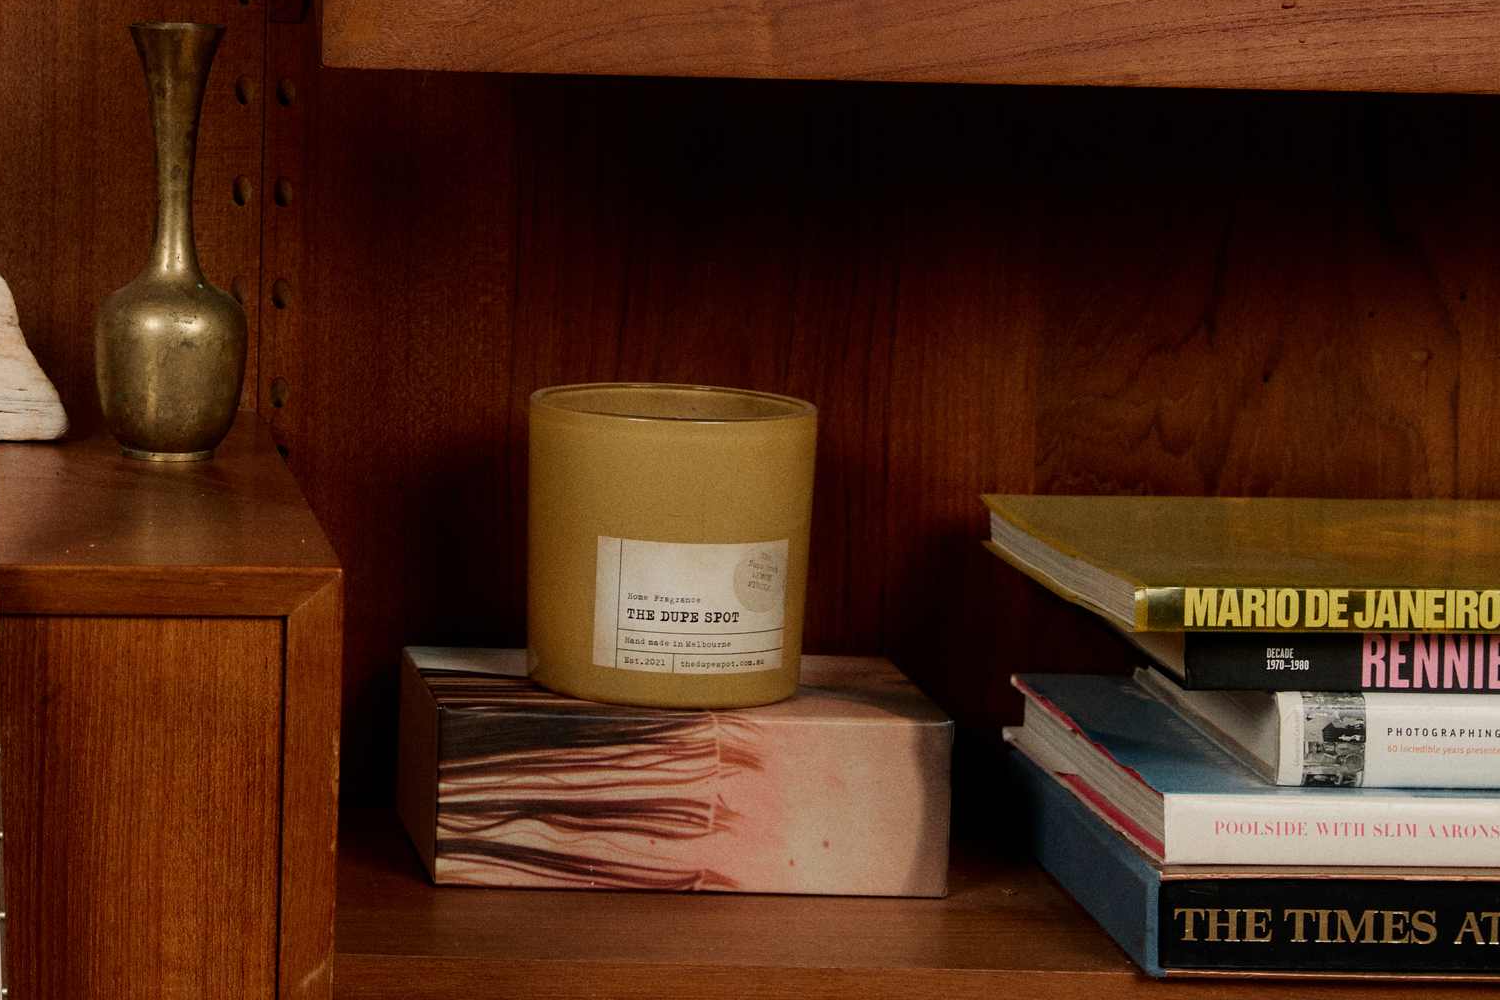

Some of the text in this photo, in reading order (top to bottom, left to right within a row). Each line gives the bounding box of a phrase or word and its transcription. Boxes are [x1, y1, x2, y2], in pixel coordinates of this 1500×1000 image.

[627, 592, 701, 605] Home Fragrance
[626, 607, 740, 624] THE DUPE SPOT
[1183, 587, 1500, 630] MARIO DE JANEIRO
[624, 636, 732, 649] Hand made in Melbourne
[1266, 648, 1295, 659] DECADE
[1361, 633, 1500, 689] RENNIE
[1386, 727, 1500, 739] PHOTOGRAPHING
[1214, 820, 1500, 839] POOLSIDE WITH SLIM AARONS
[1173, 907, 1273, 943] THE
[1283, 908, 1438, 946] TIMES
